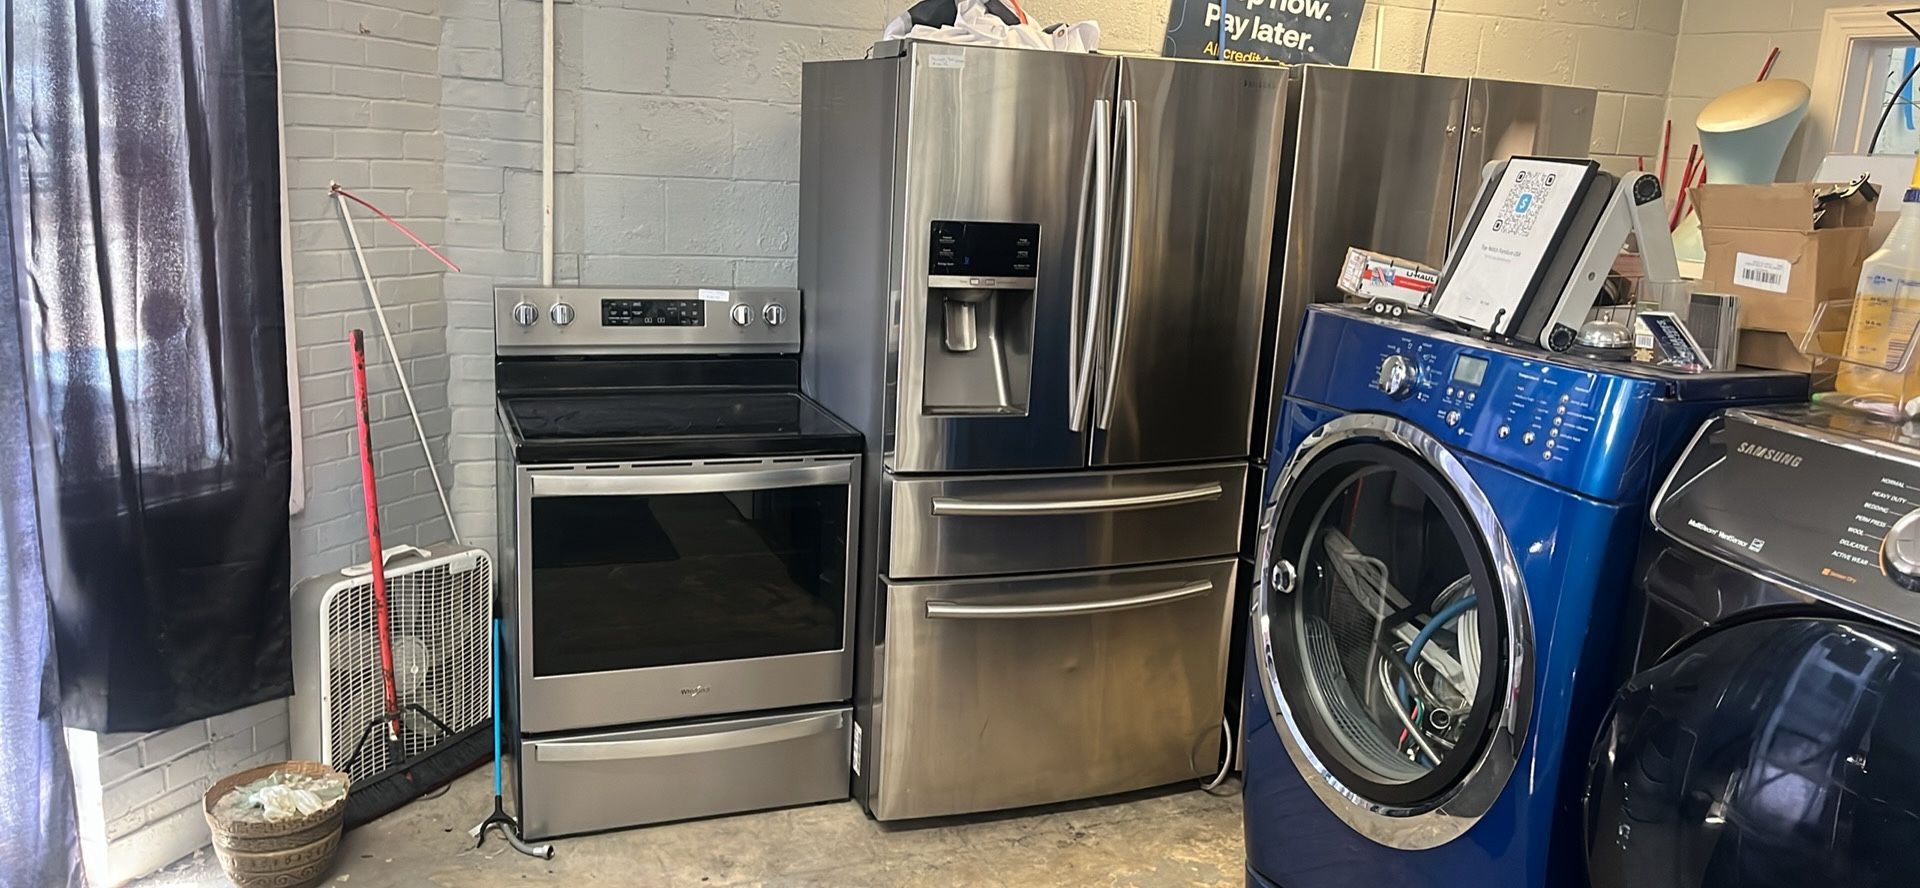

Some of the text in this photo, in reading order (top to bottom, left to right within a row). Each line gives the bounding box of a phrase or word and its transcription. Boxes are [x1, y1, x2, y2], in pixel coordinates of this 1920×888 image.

[1204, 2, 1314, 53] Pay later.
[1223, 48, 1261, 62] credit
[1737, 441, 1803, 468] SAMSUNG
[1881, 477, 1905, 488] NORMAL
[1872, 490, 1907, 504] HEAVY DUTY
[1863, 502, 1889, 514] BEDDING
[1847, 527, 1864, 536] WOOL
[1839, 538, 1869, 552] DELICATES
[1831, 550, 1869, 565] ACTIVE WEAR
